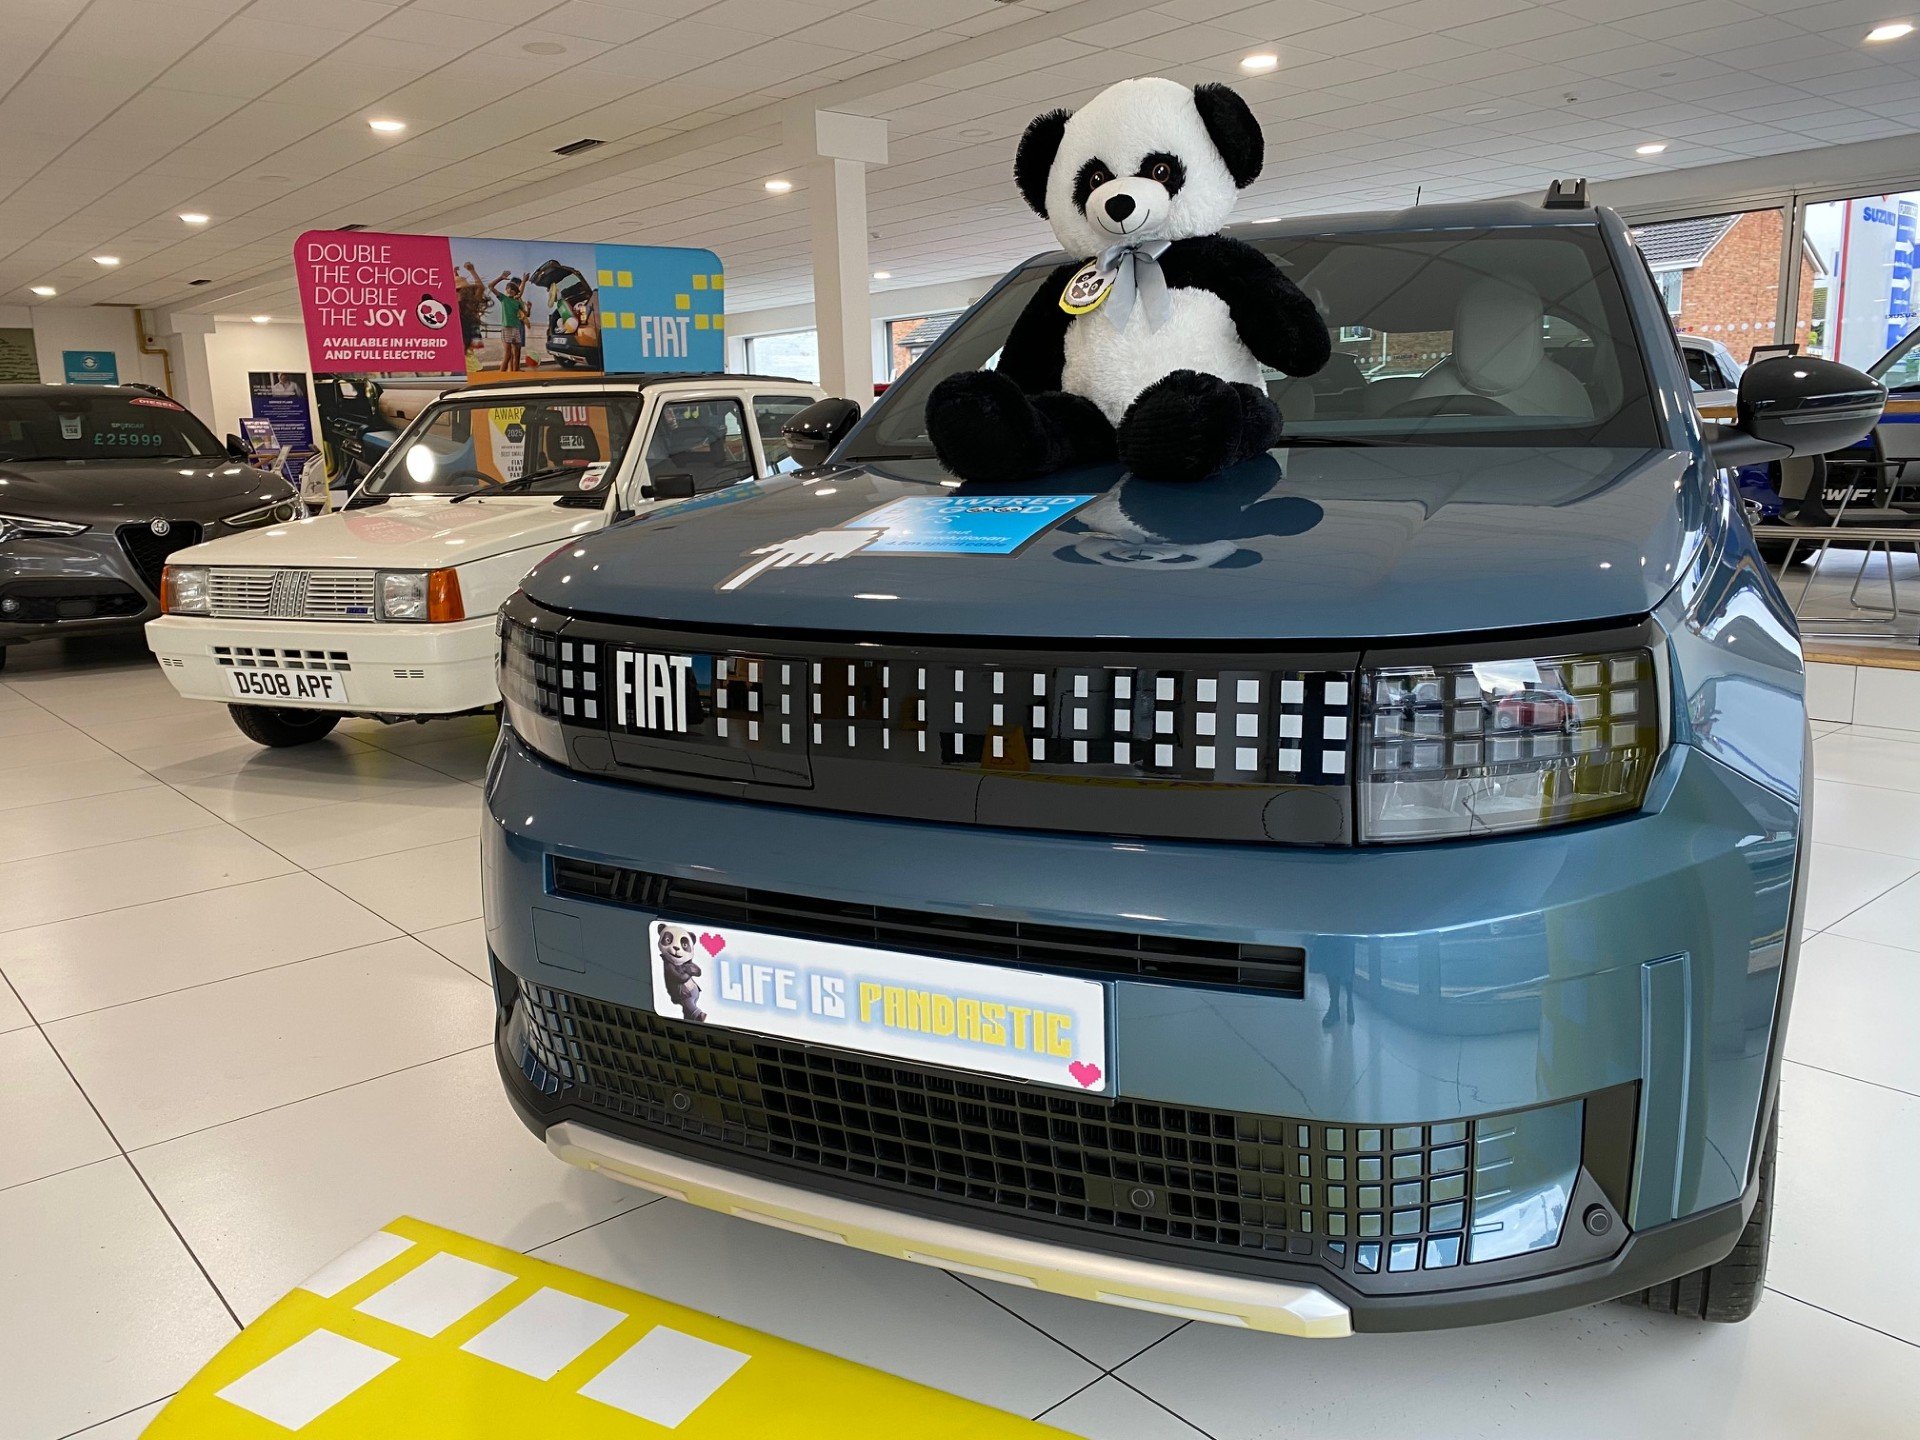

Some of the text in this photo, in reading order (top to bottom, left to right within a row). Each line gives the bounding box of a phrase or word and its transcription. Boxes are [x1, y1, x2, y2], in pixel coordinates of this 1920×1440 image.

[308, 243, 391, 263] DOUBLE
[311, 265, 442, 289] THE CHOICE,
[315, 287, 398, 306] DOUBLE
[318, 308, 406, 327] THE JOY
[323, 338, 448, 348] AVAILABLE IN HYBRID
[641, 316, 690, 358] FIAT
[325, 350, 436, 360] AND FULL ELECTRIC
[94, 432, 162, 446] £25999
[233, 671, 333, 698] D508 APF
[616, 650, 692, 733] FIAT
[719, 960, 1072, 1059] LIFE IS PANDASTIC
